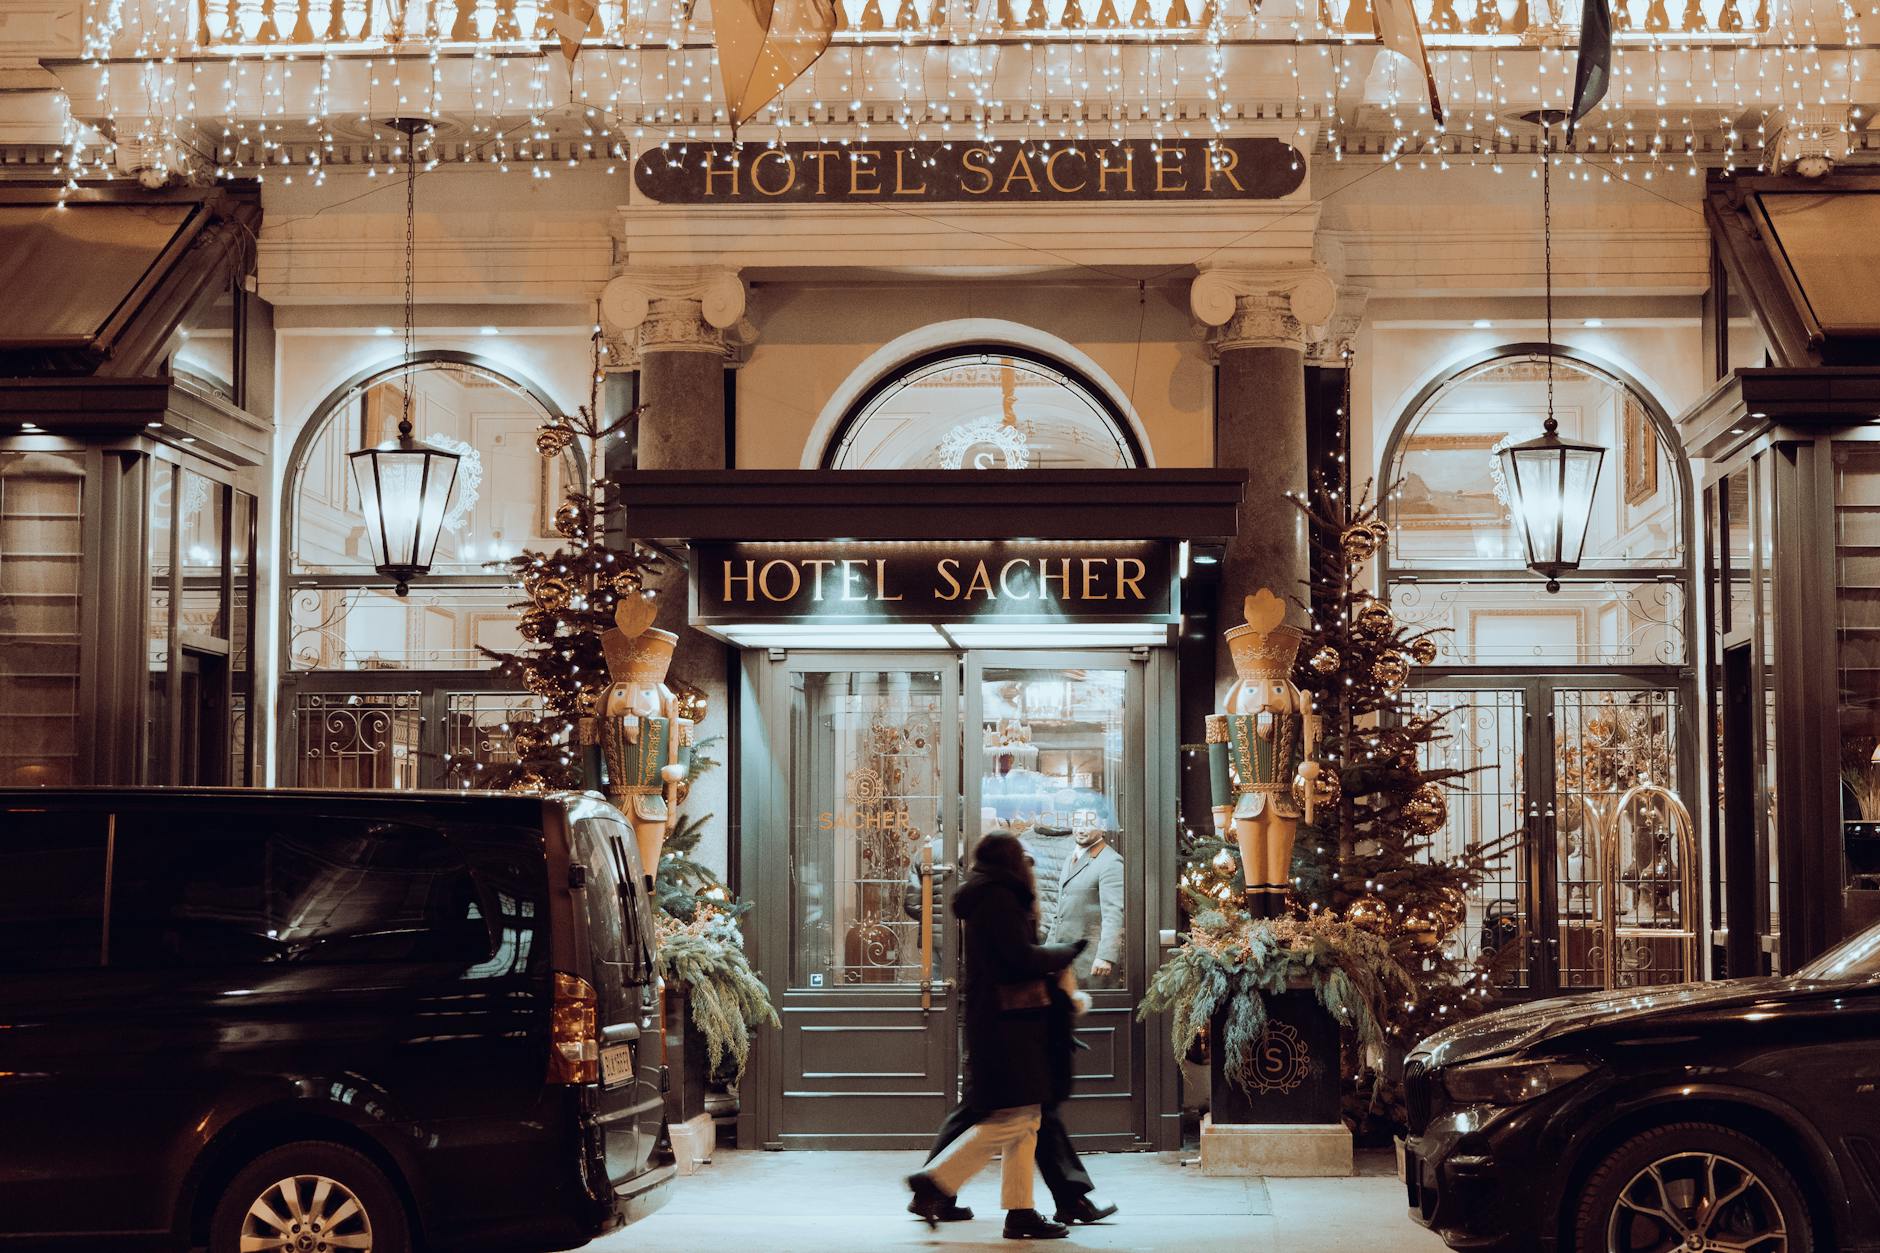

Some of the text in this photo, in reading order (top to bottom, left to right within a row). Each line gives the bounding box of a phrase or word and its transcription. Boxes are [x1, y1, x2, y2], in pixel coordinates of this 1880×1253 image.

[704, 147, 1246, 196] HOTEL SACHER
[722, 557, 1147, 602] HOTEL SACHER
[860, 782, 870, 796] S
[818, 811, 910, 830] SACHER
[1013, 811, 1098, 828] SACHER
[1265, 1047, 1283, 1073] S
